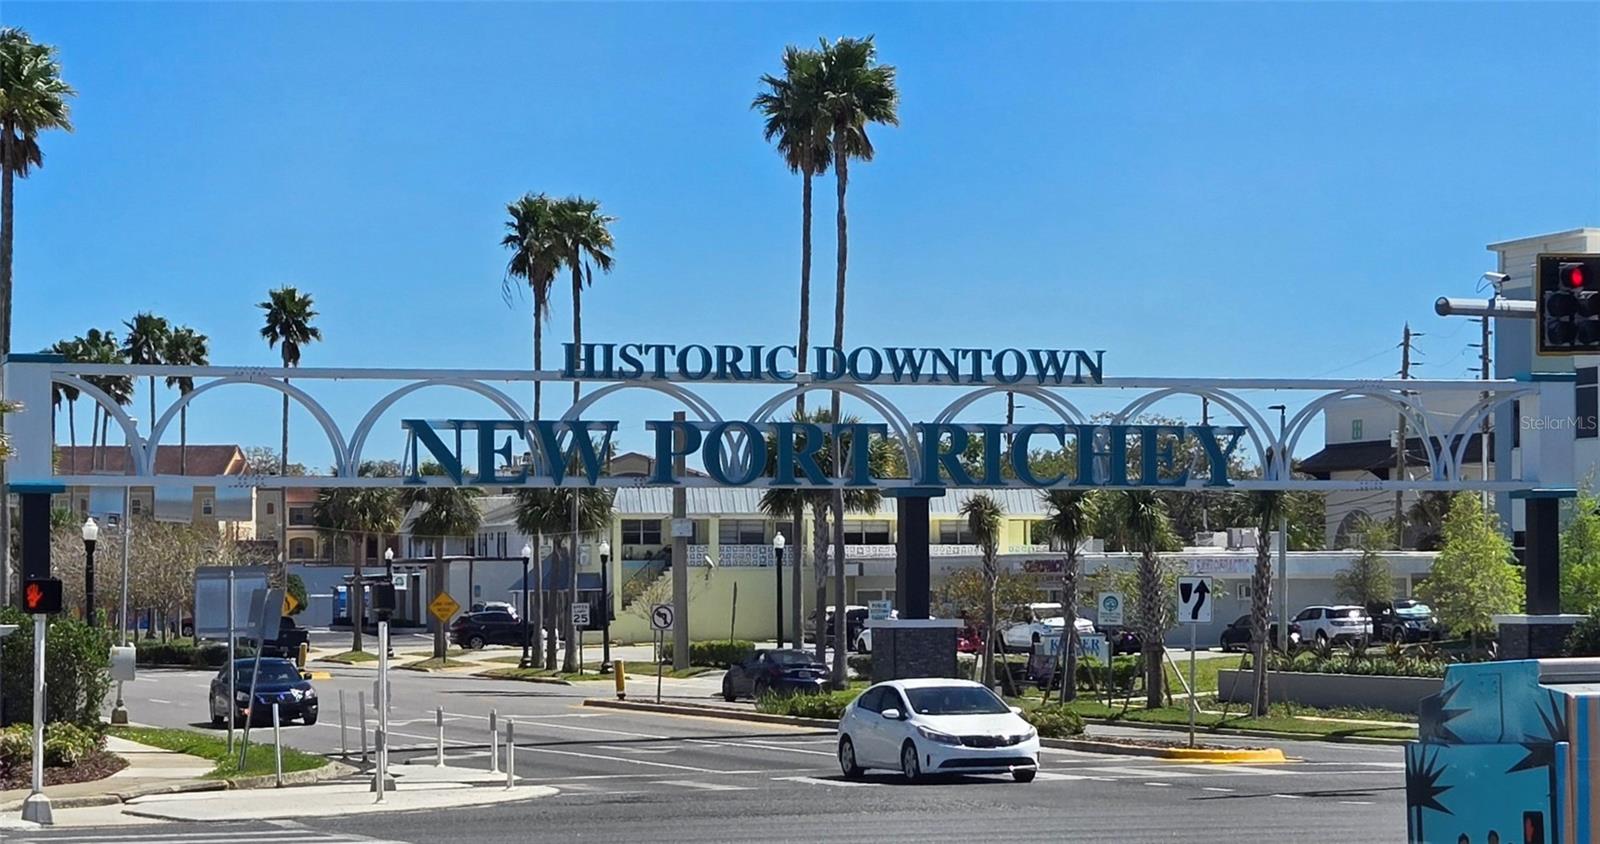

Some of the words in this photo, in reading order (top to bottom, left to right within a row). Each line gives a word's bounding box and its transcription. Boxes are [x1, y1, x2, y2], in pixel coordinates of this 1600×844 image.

[561, 342, 798, 381] HISTORIC
[812, 346, 1107, 385] DOWNTOWN
[401, 418, 620, 486] NEW
[645, 419, 888, 487] PORT
[911, 422, 1249, 488] RICHEY
[573, 614, 588, 623] 25
